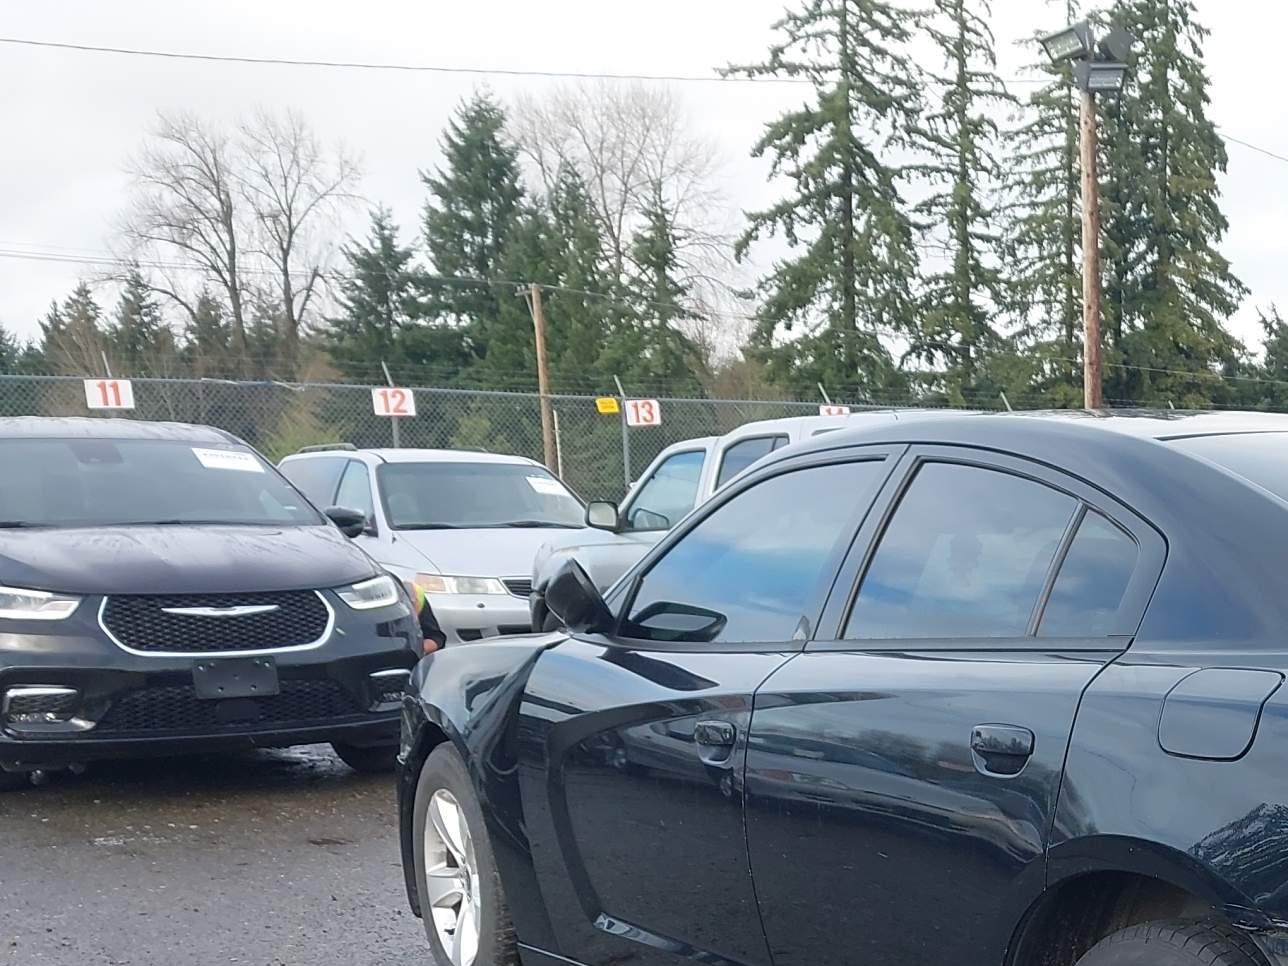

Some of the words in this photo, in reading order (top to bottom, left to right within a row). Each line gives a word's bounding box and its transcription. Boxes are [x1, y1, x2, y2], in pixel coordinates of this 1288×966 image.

[96, 381, 121, 407] 11
[380, 390, 408, 413] 12
[632, 401, 654, 423] 13
